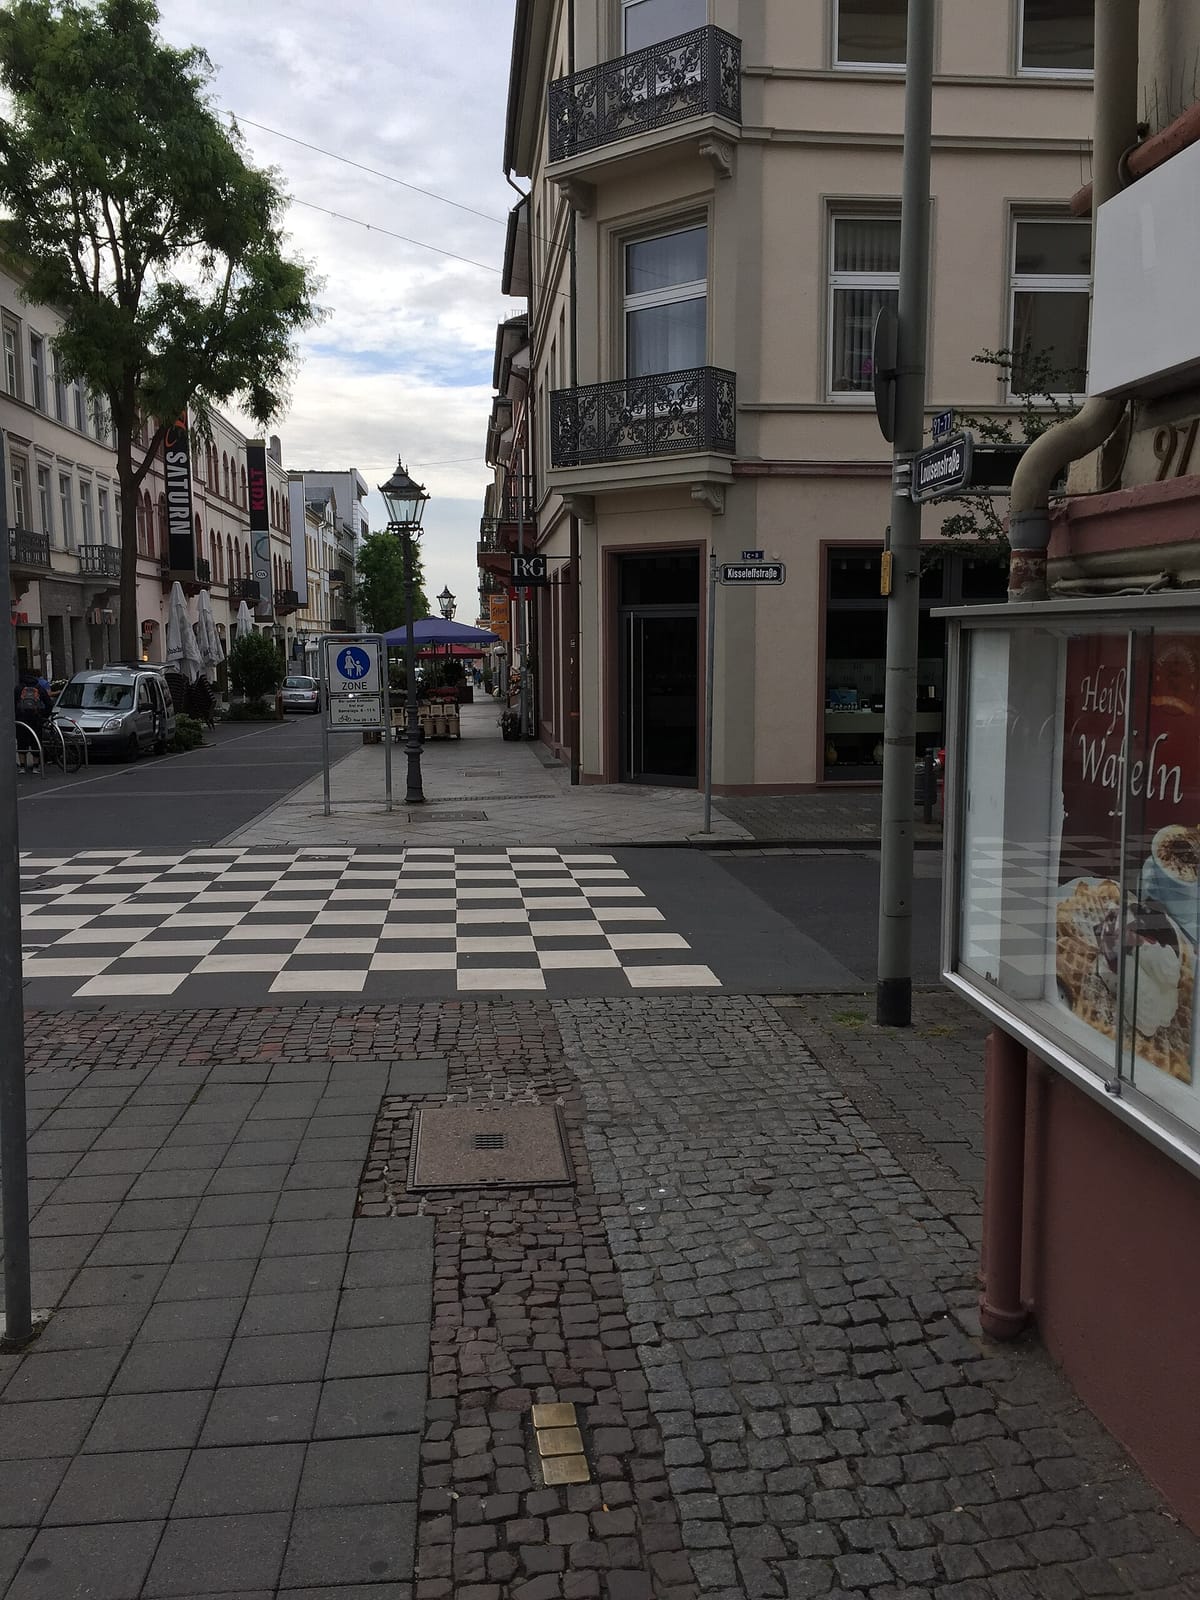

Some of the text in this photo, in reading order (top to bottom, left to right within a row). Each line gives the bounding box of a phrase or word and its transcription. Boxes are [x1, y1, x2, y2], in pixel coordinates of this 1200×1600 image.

[920, 448, 960, 485] Louisenstraße
[1153, 418, 1200, 482] 97
[166, 451, 191, 535] SATURN
[252, 469, 265, 511] KULT
[342, 681, 368, 691] ZONE
